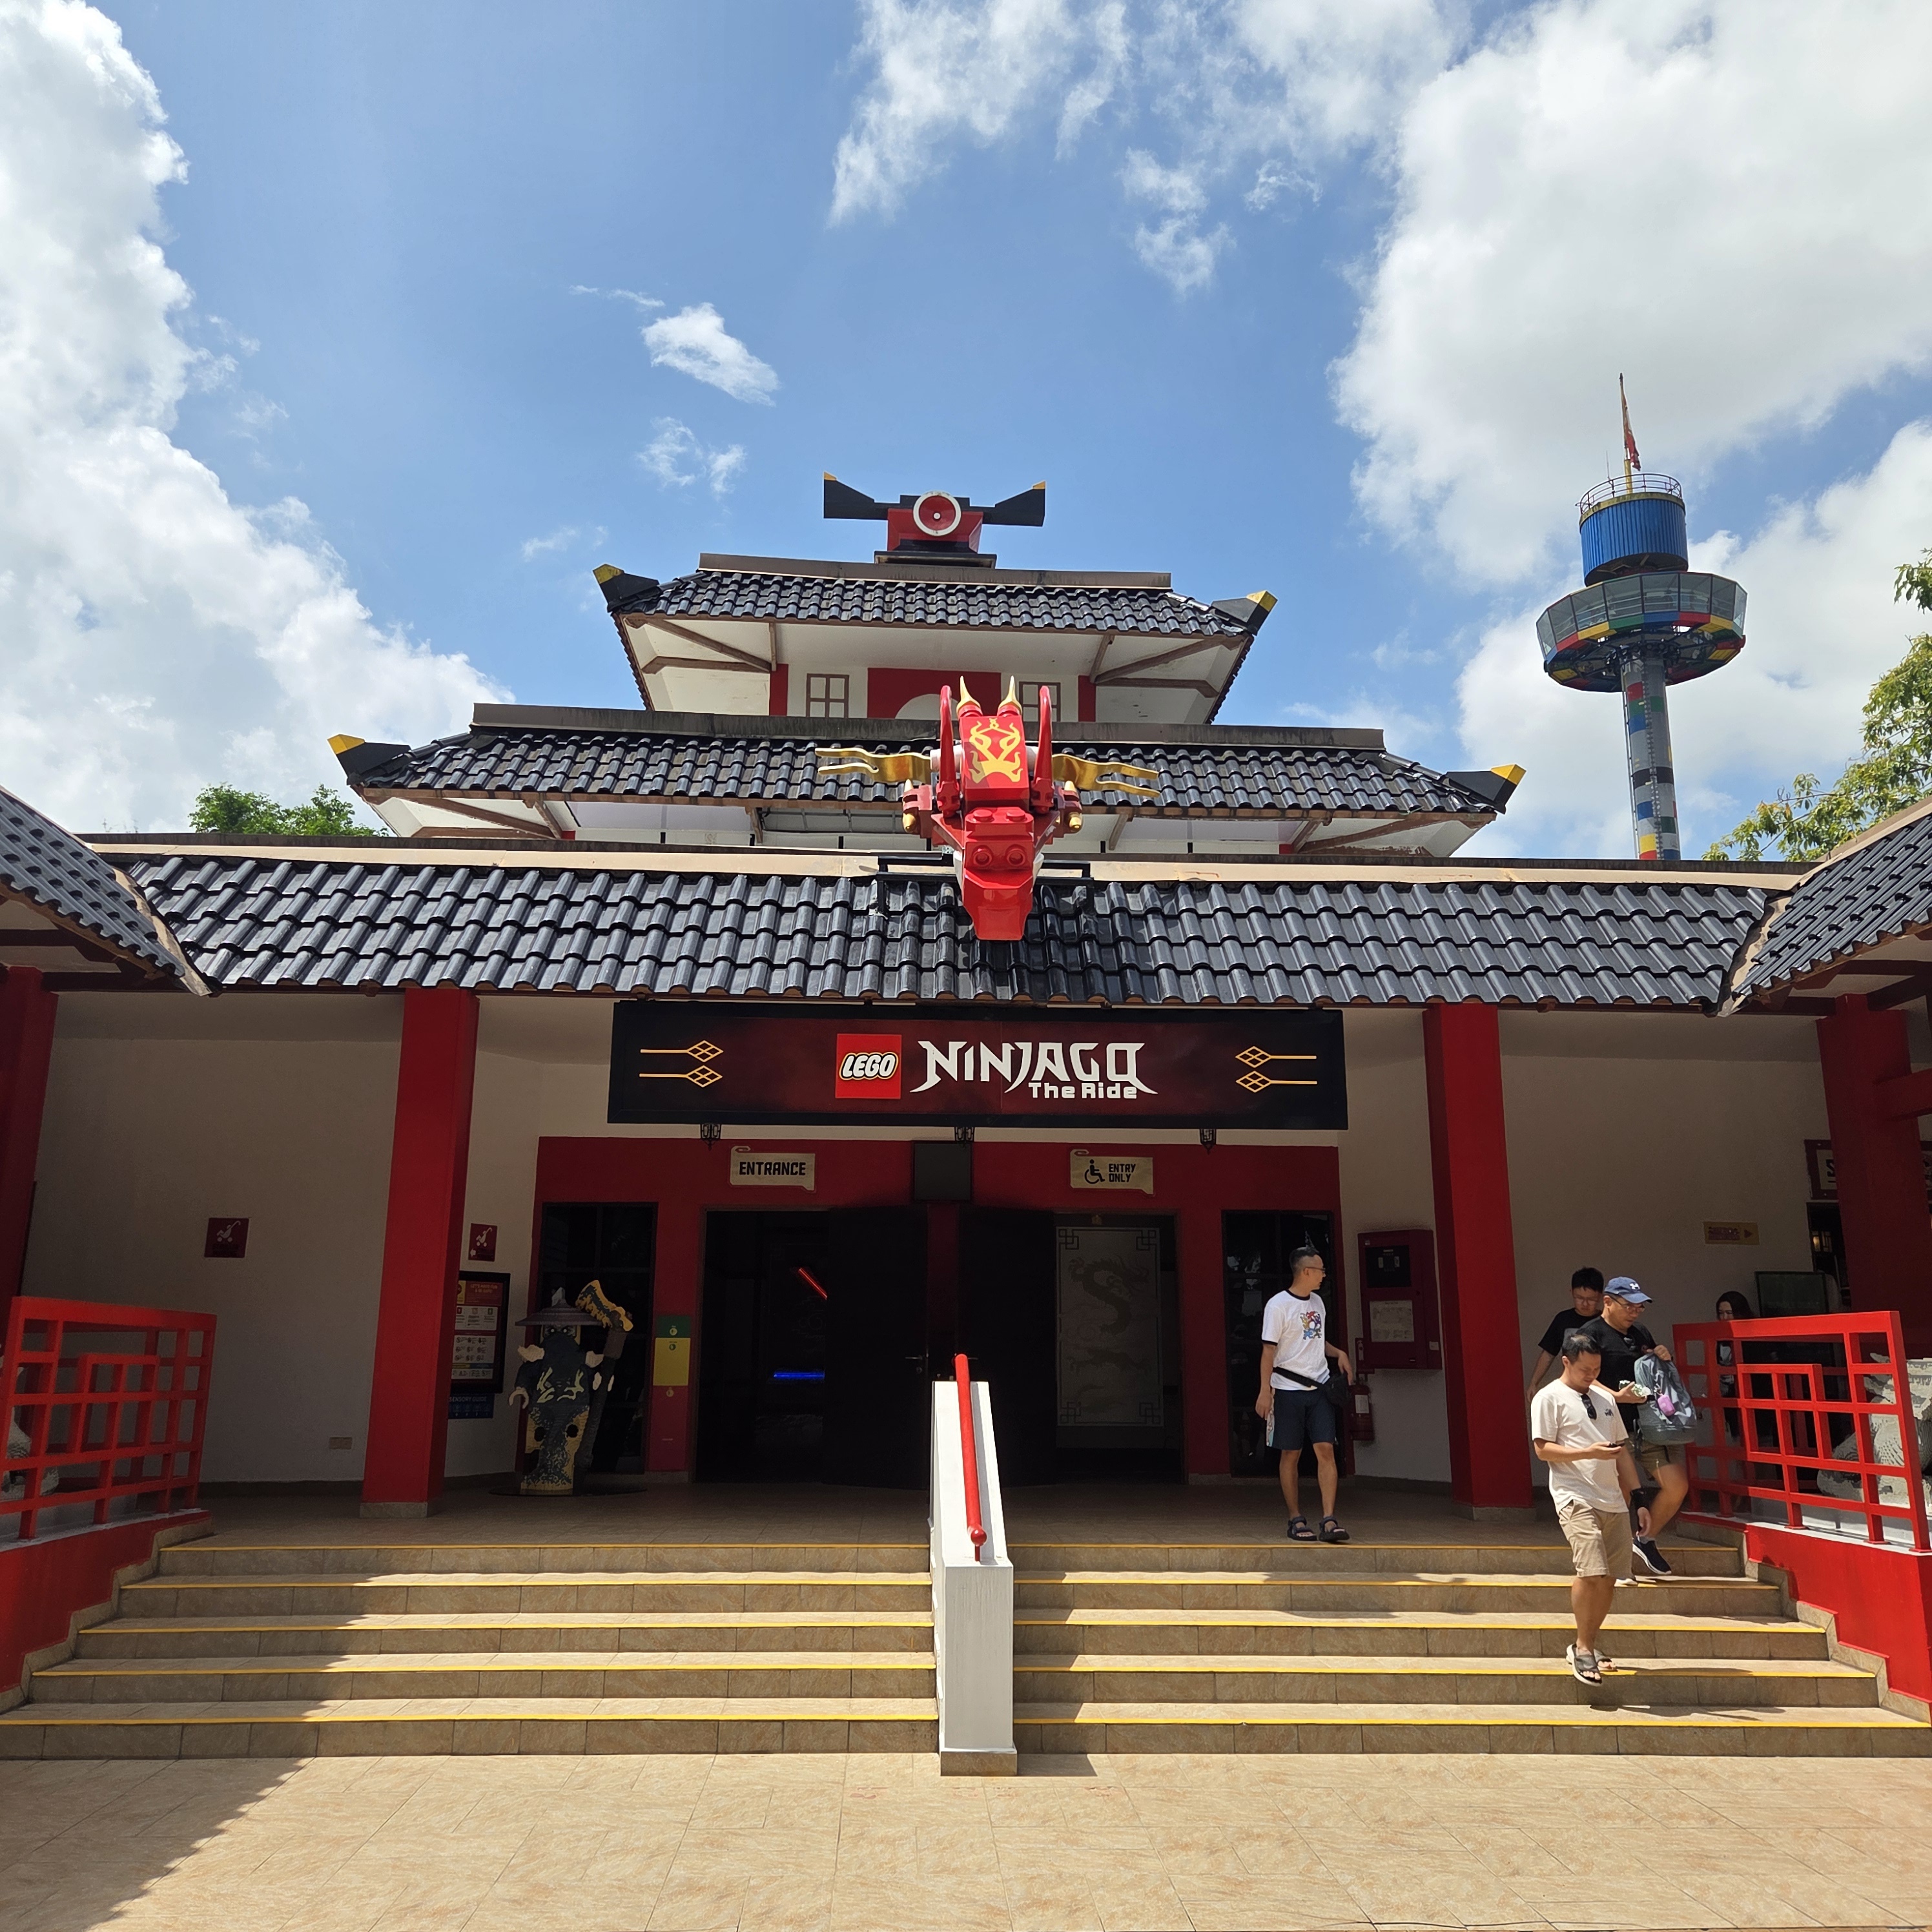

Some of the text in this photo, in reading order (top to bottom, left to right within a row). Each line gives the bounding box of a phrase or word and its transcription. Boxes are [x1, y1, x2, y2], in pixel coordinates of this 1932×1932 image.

[841, 1054, 896, 1078] LEGO
[910, 1041, 1158, 1094] NINJAGO
[1028, 1082, 1137, 1099] The Ride
[739, 1161, 806, 1176] ENTRANCE
[1109, 1164, 1136, 1173] ENTRY
[1109, 1173, 1131, 1182] ONLY
